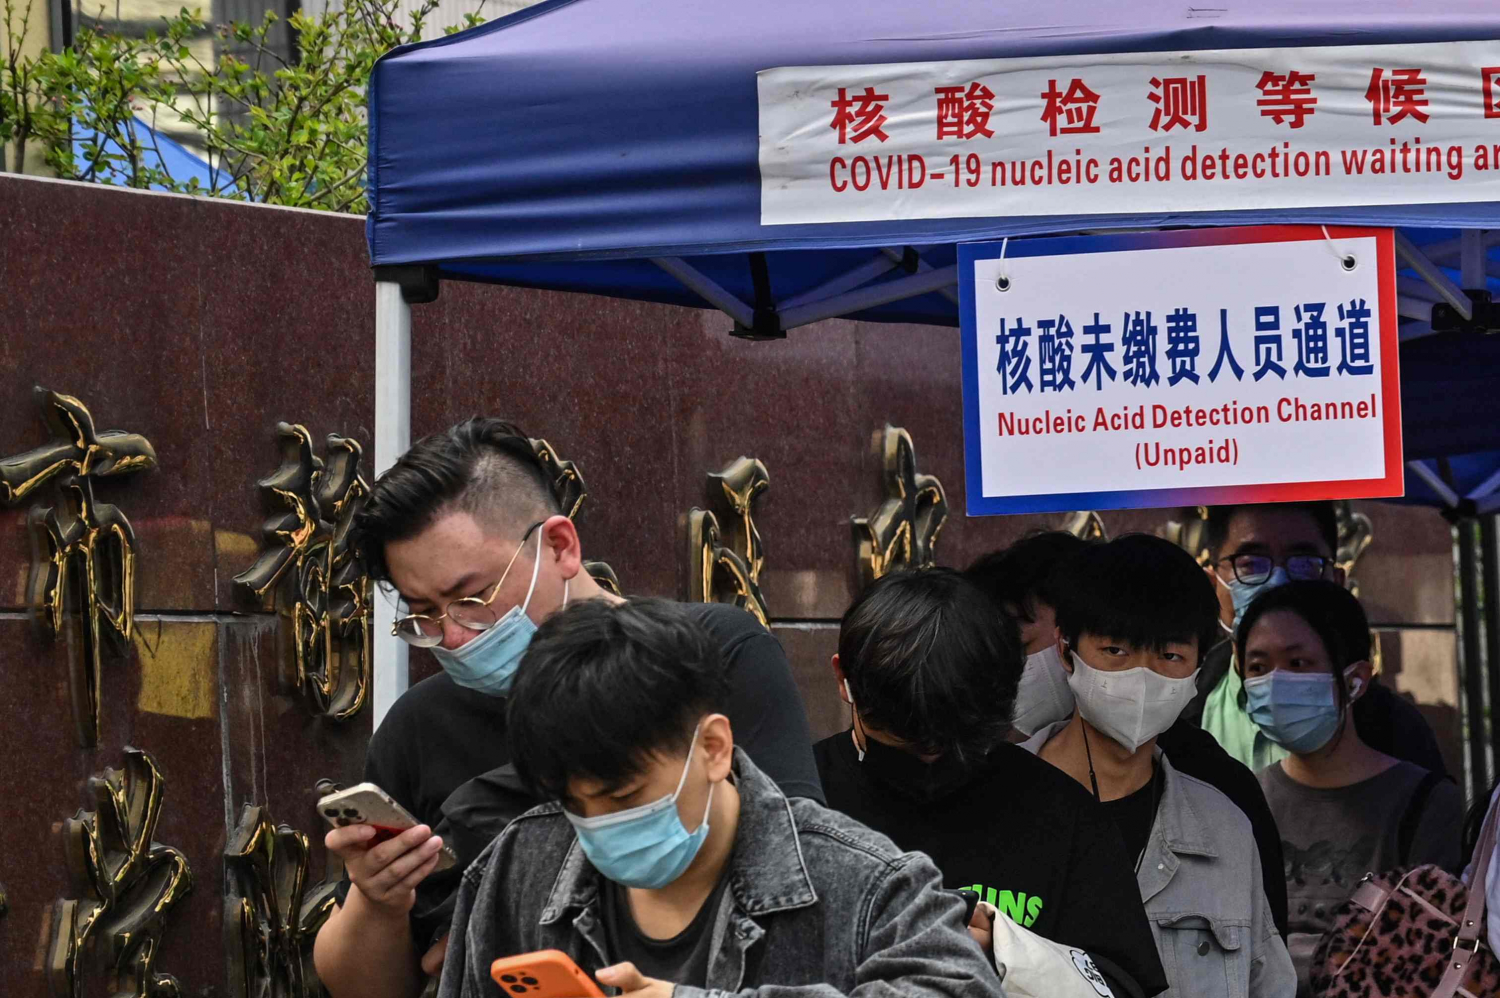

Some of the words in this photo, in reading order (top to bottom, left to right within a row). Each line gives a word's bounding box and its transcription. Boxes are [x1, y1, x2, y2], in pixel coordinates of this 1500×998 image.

[829, 153, 982, 193] COVID-19
[990, 148, 1099, 187] nucleic
[1108, 145, 1171, 183] acid
[1179, 141, 1331, 181] detection
[1340, 137, 1464, 182] waiting
[997, 299, 1375, 396] 核酸未缴费人员通道
[998, 408, 1087, 438] Nucleic
[1092, 405, 1145, 432] Acid
[1152, 400, 1269, 431] Detection
[1276, 394, 1377, 426] Channel
[1134, 438, 1240, 471] (Unpaid)
